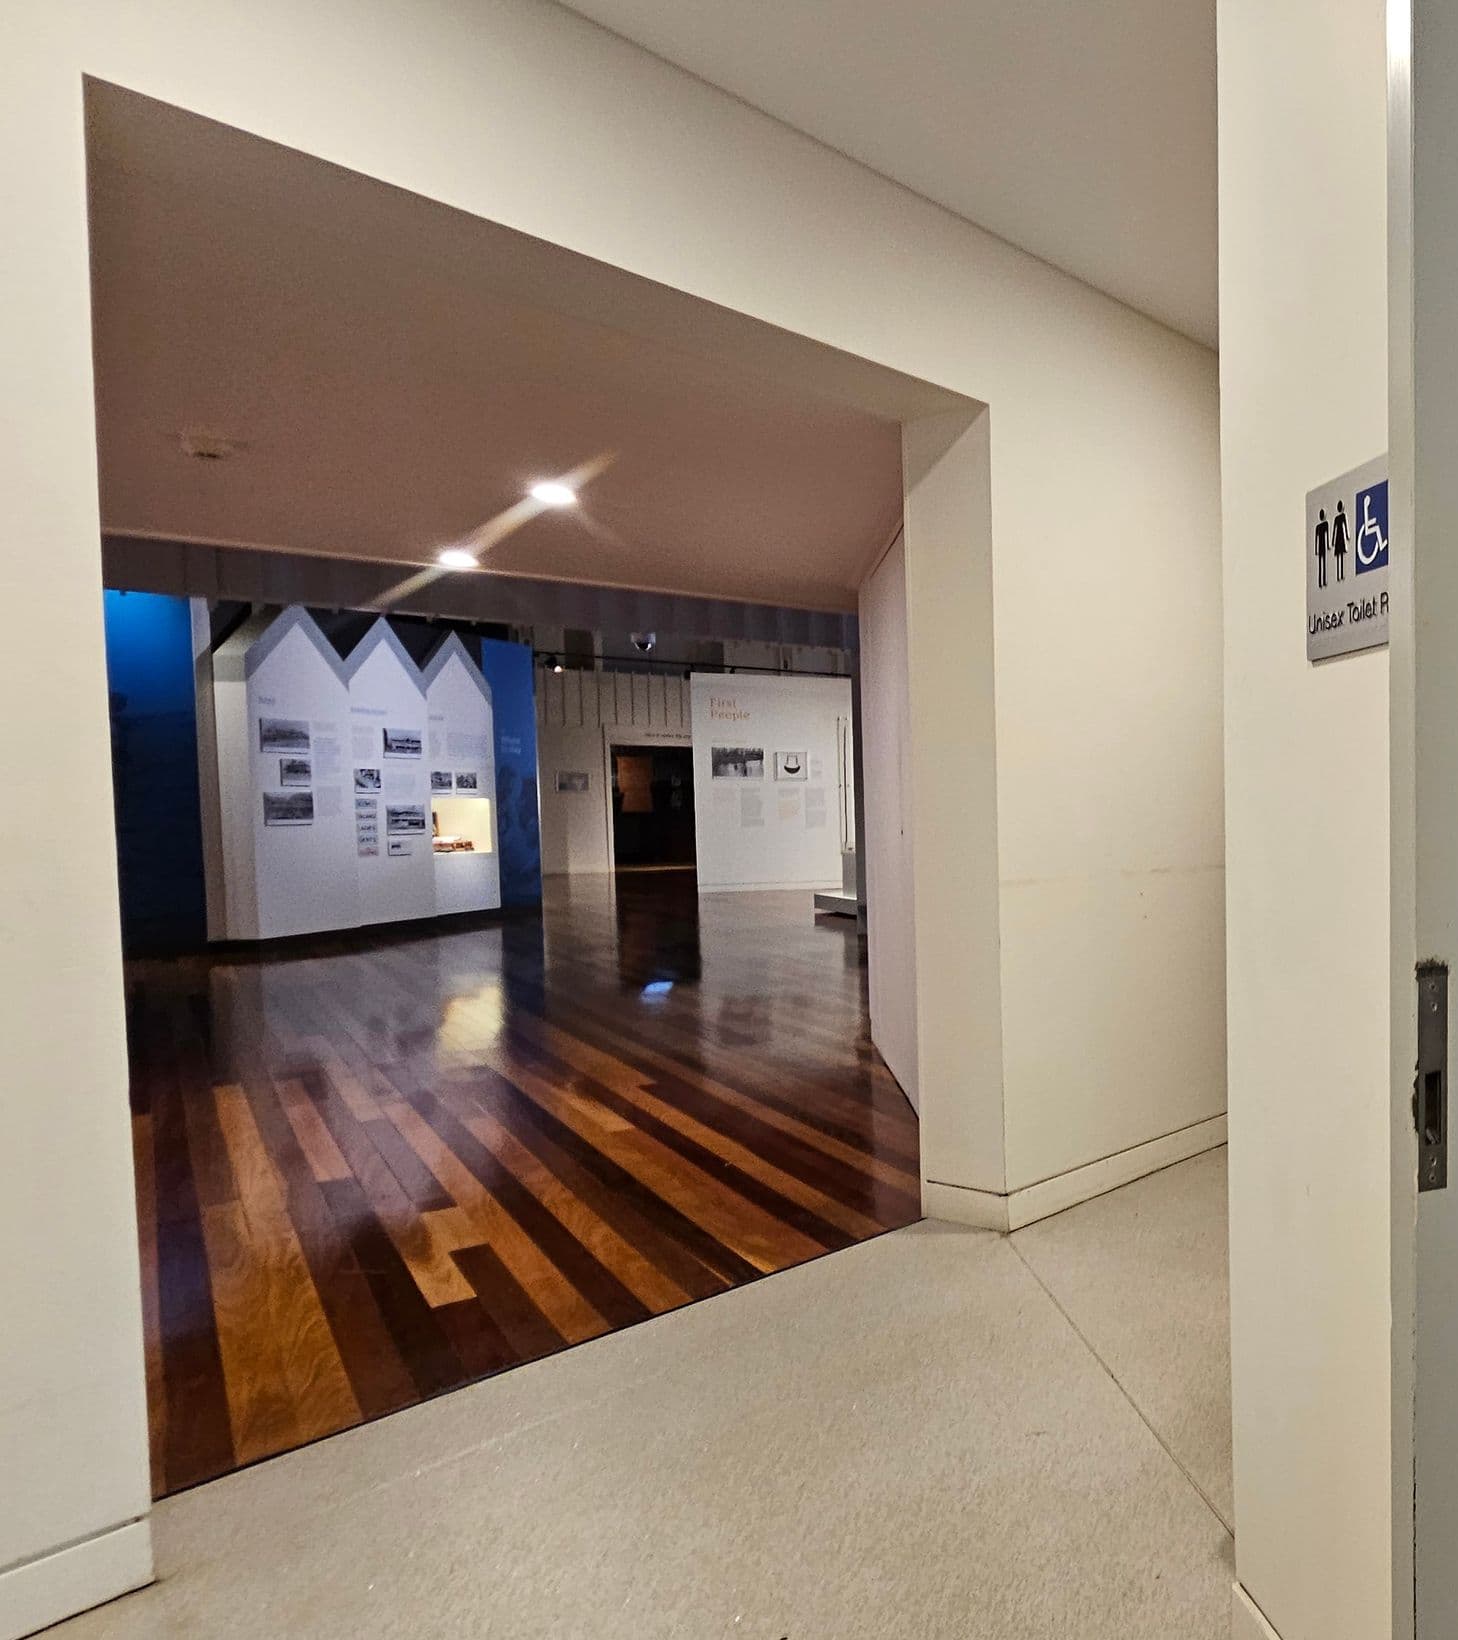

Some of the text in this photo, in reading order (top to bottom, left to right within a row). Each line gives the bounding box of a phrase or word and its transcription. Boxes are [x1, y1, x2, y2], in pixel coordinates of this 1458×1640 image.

[1308, 611, 1344, 634] Unisex
[1347, 595, 1377, 624] Toilet
[710, 697, 737, 707] First
[710, 710, 751, 721] People
